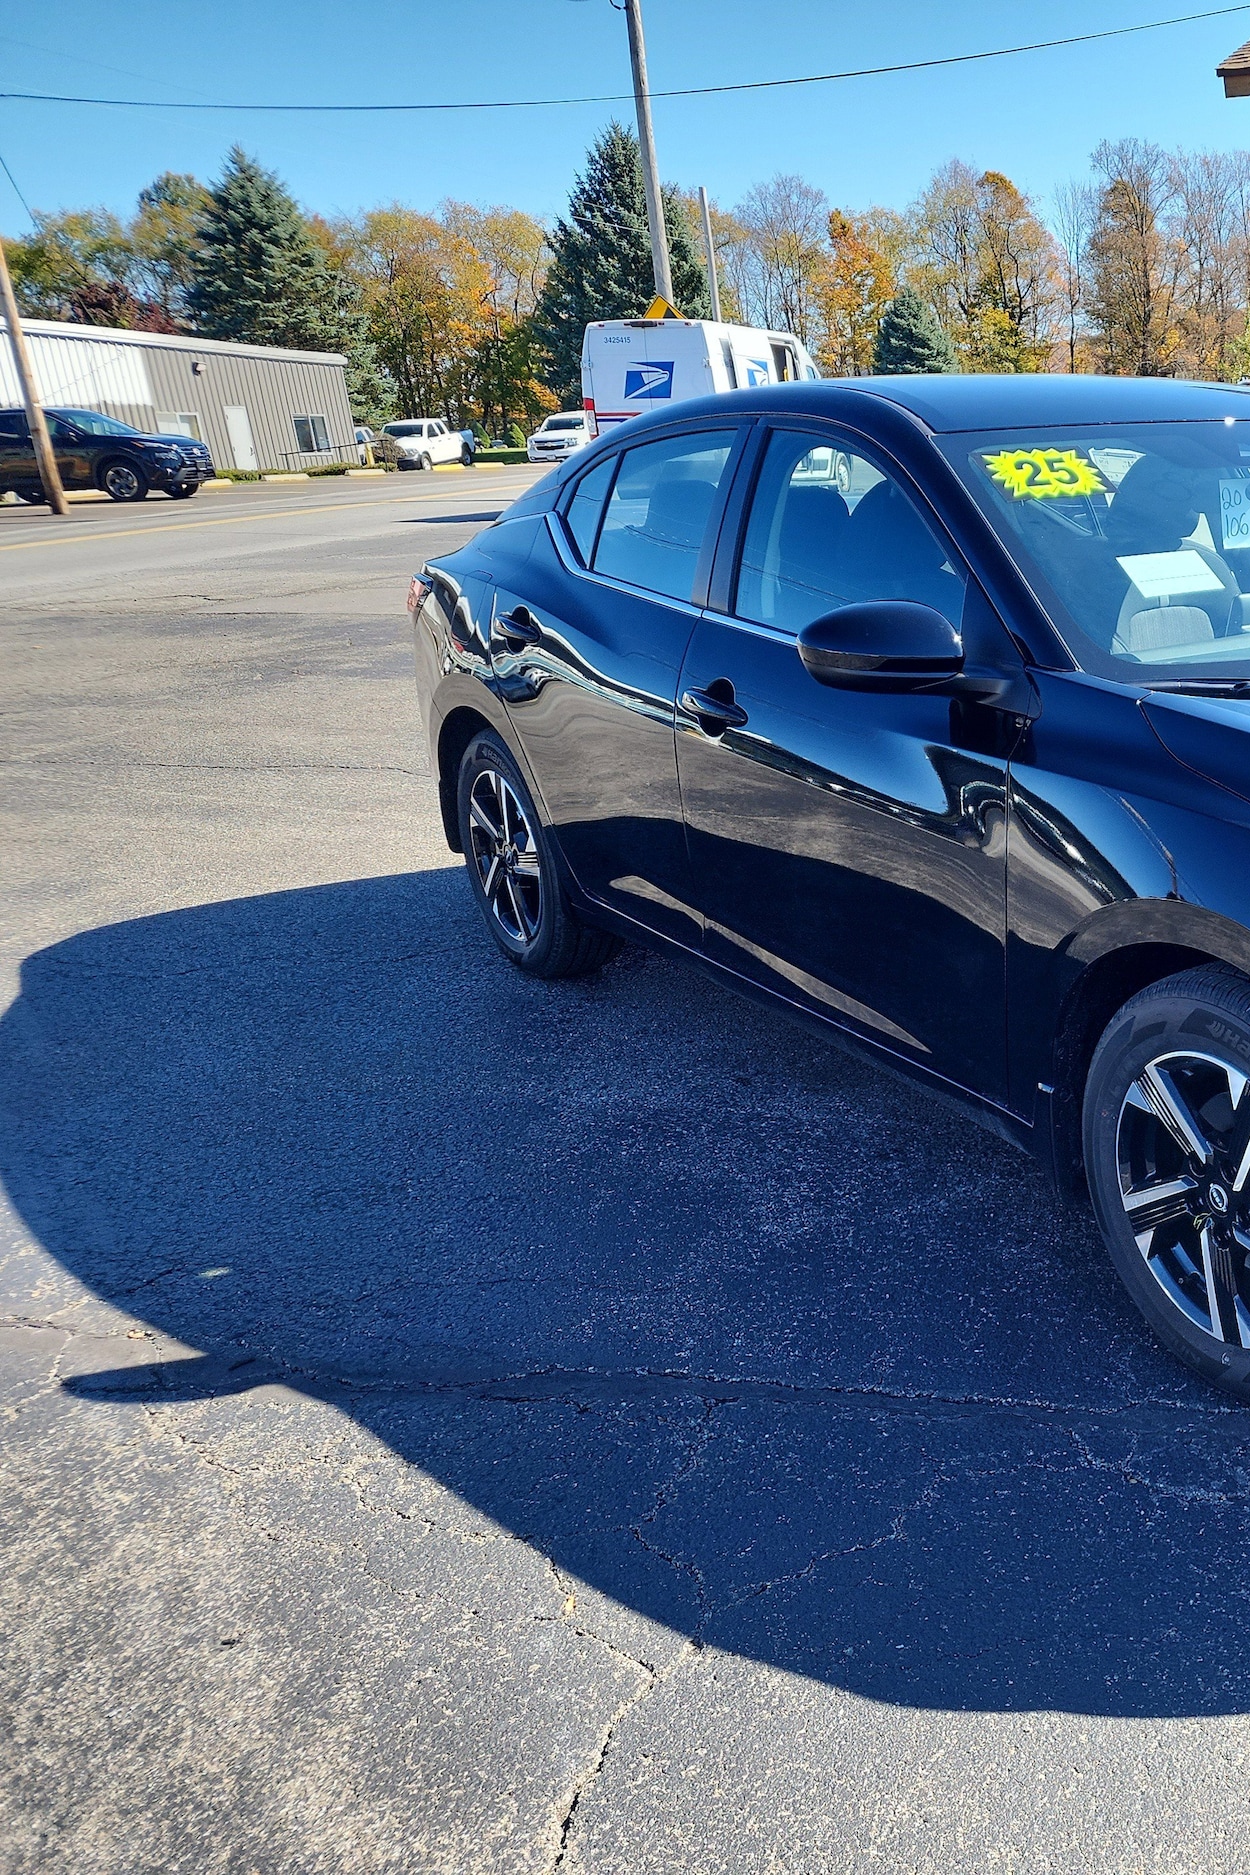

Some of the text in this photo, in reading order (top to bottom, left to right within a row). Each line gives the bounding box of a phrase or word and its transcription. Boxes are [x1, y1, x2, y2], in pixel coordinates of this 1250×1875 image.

[603, 336, 631, 344] 3425415
[1014, 457, 1079, 486] 25
[1221, 486, 1242, 510] 20
